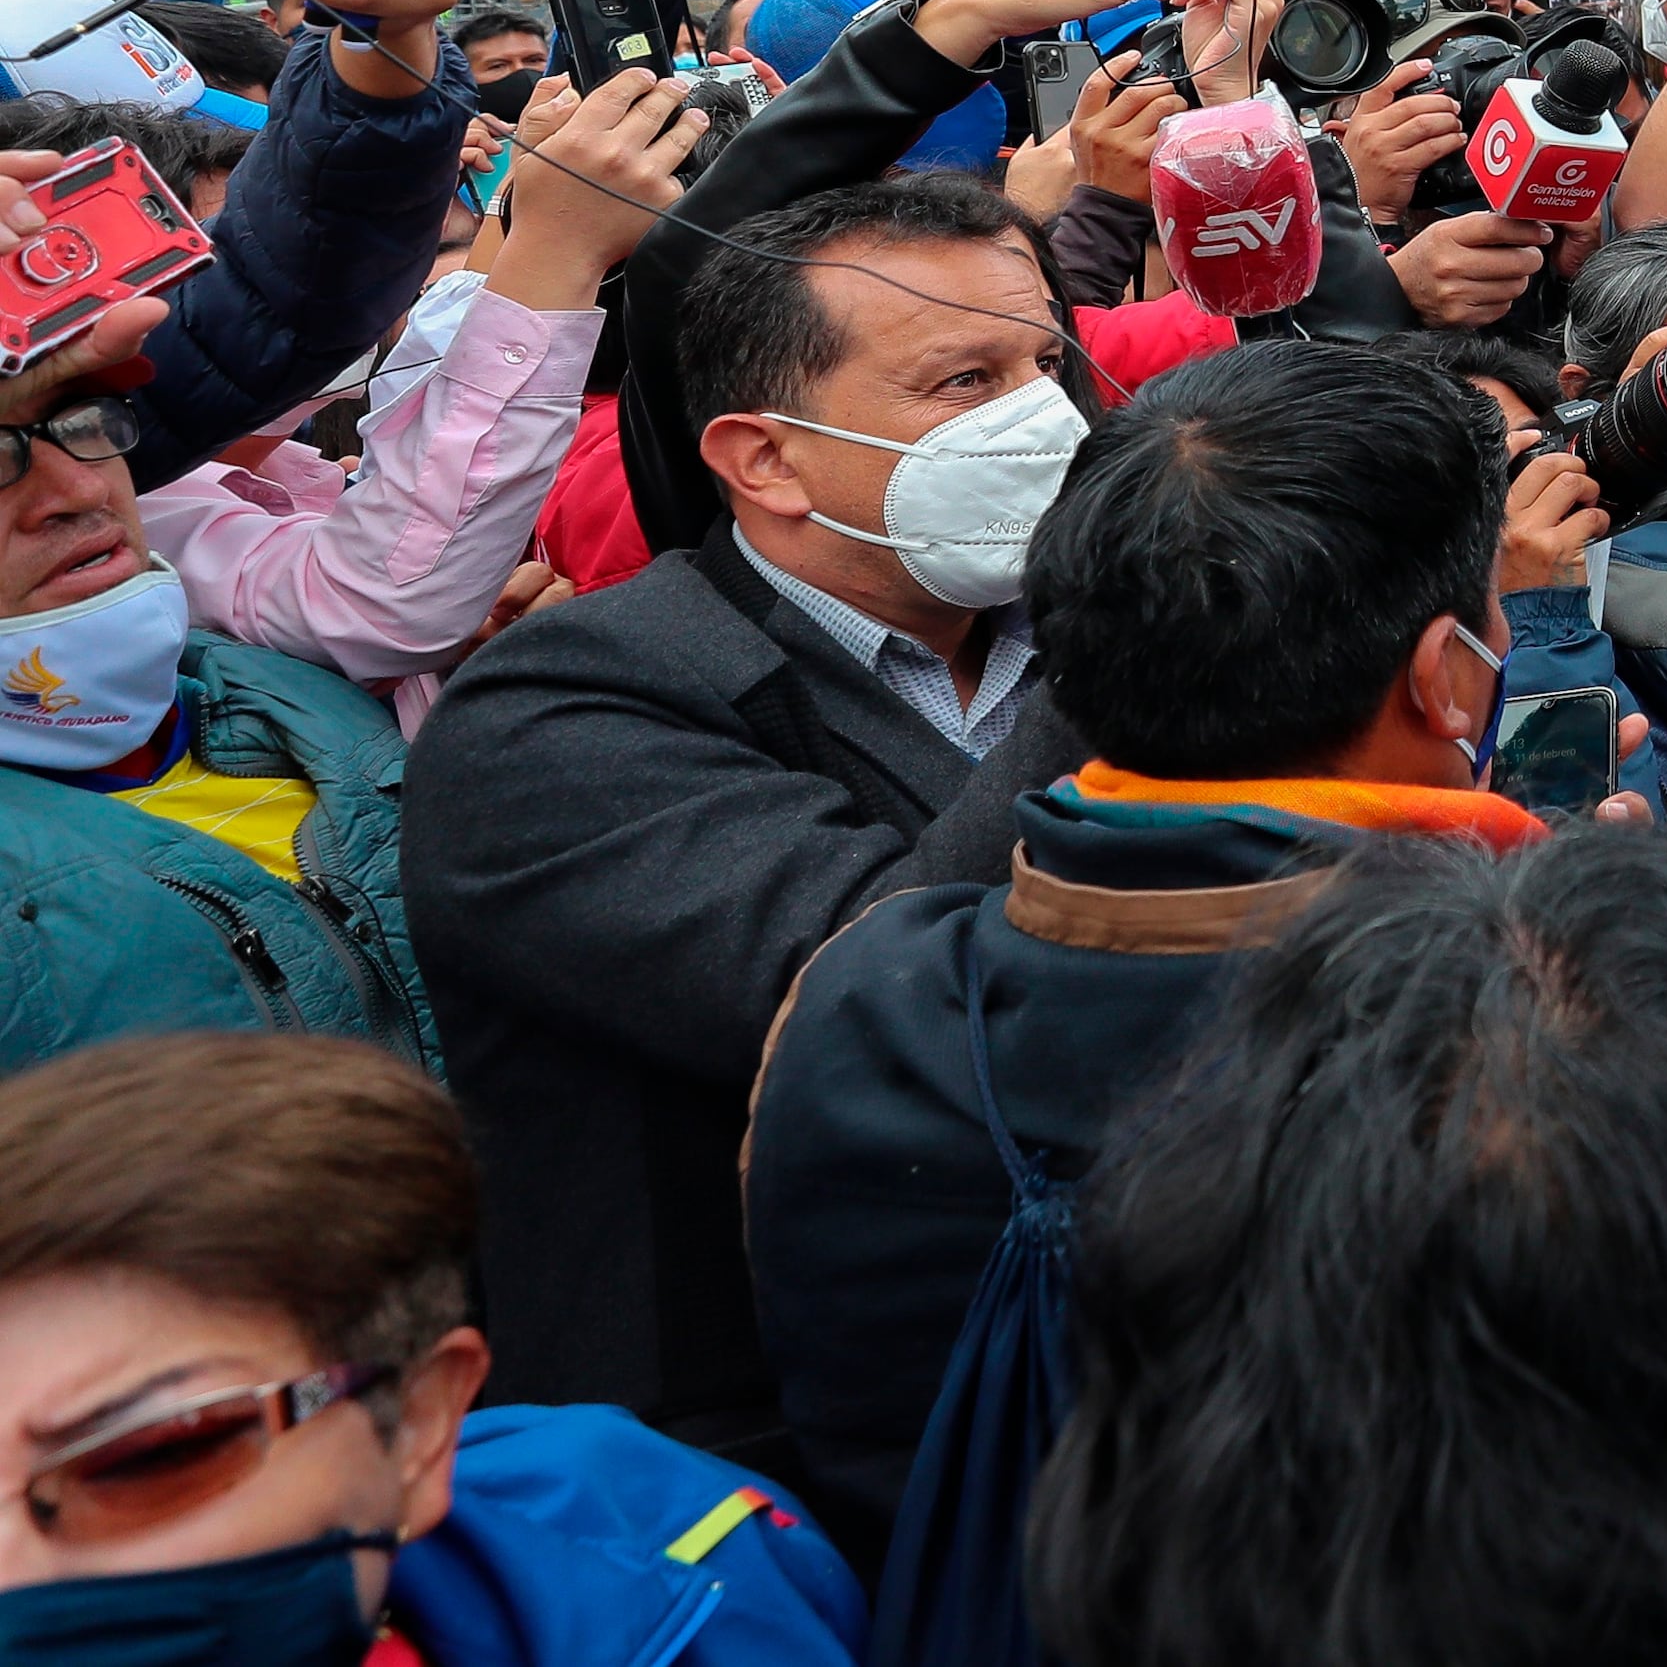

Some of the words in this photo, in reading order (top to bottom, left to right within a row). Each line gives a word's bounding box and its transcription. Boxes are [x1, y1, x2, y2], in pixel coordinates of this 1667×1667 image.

[1527, 183, 1596, 199] Gamavisión
[1533, 196, 1577, 207] noticias
[1564, 404, 1594, 418] SONY
[984, 519, 1032, 535] KN95
